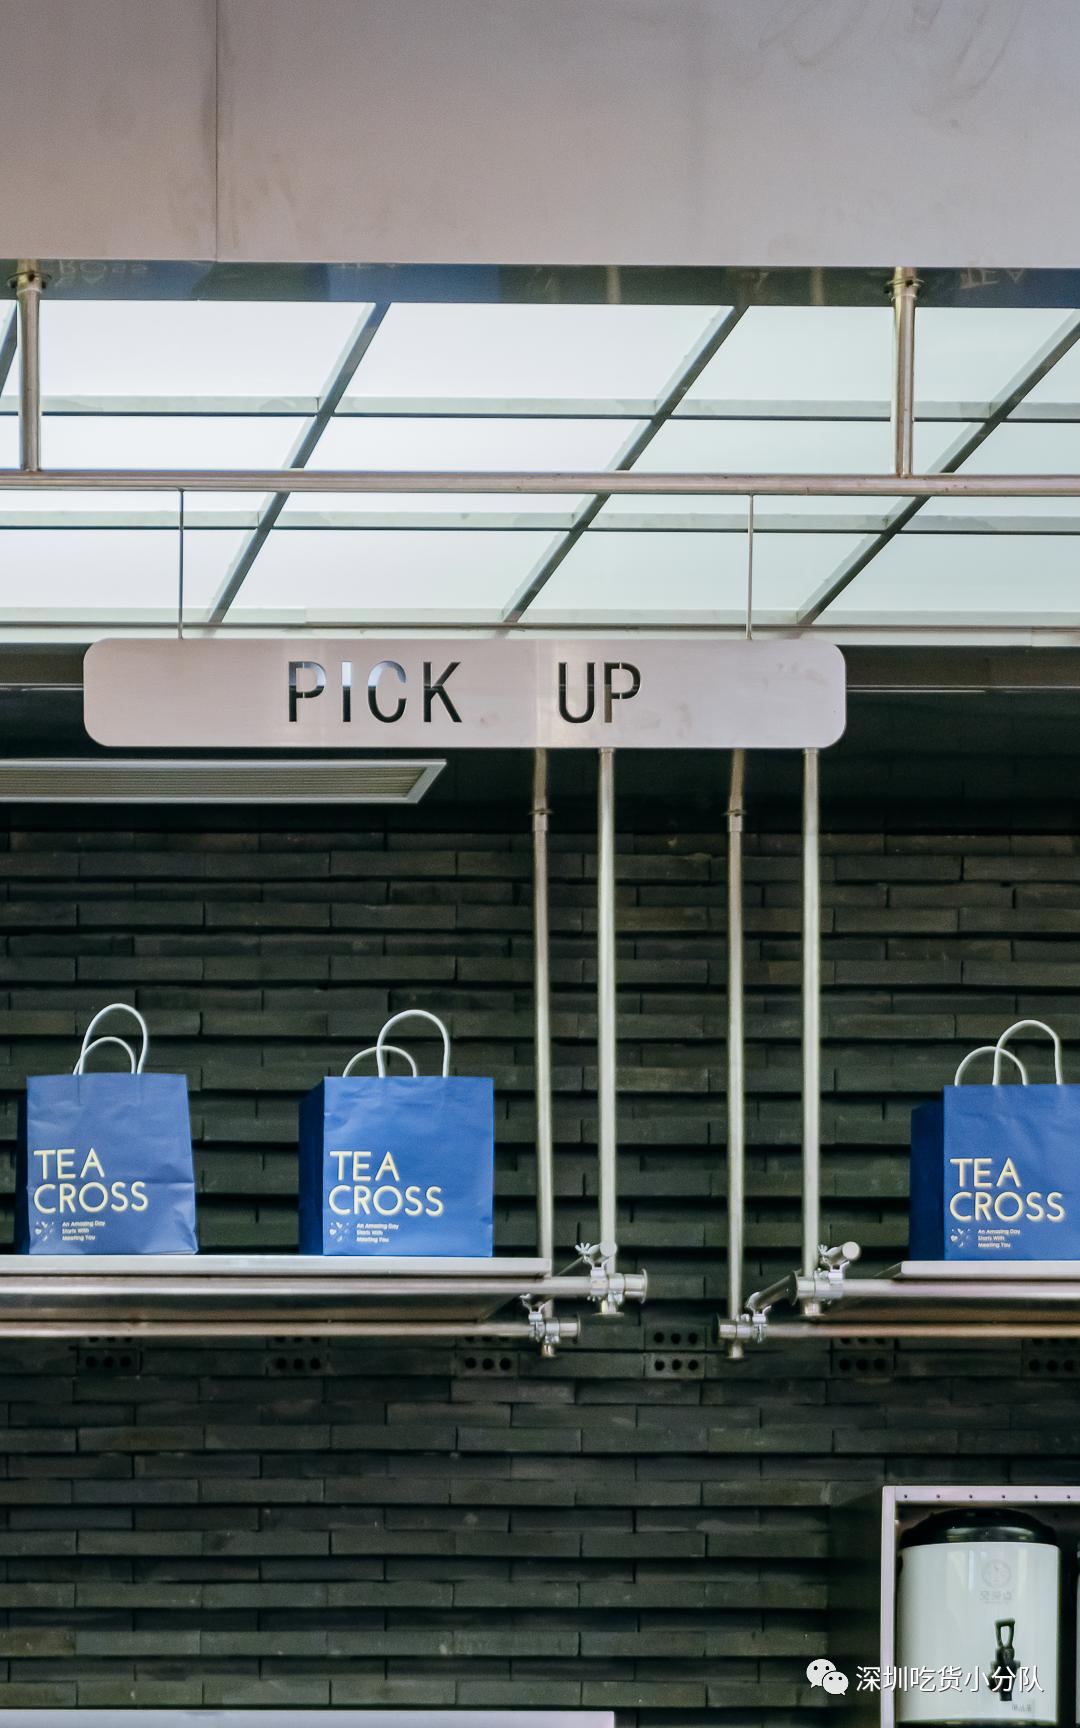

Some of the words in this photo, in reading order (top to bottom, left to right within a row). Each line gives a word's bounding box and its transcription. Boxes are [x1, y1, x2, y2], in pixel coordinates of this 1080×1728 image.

[288, 660, 462, 724] PICK
[558, 660, 641, 724] UP
[33, 1147, 105, 1180] TEA
[329, 1150, 401, 1182] TEA
[949, 1157, 1022, 1188] TEA
[33, 1181, 149, 1214] CROSS
[328, 1184, 445, 1217] CROSS
[949, 1191, 1066, 1223] CROSS
